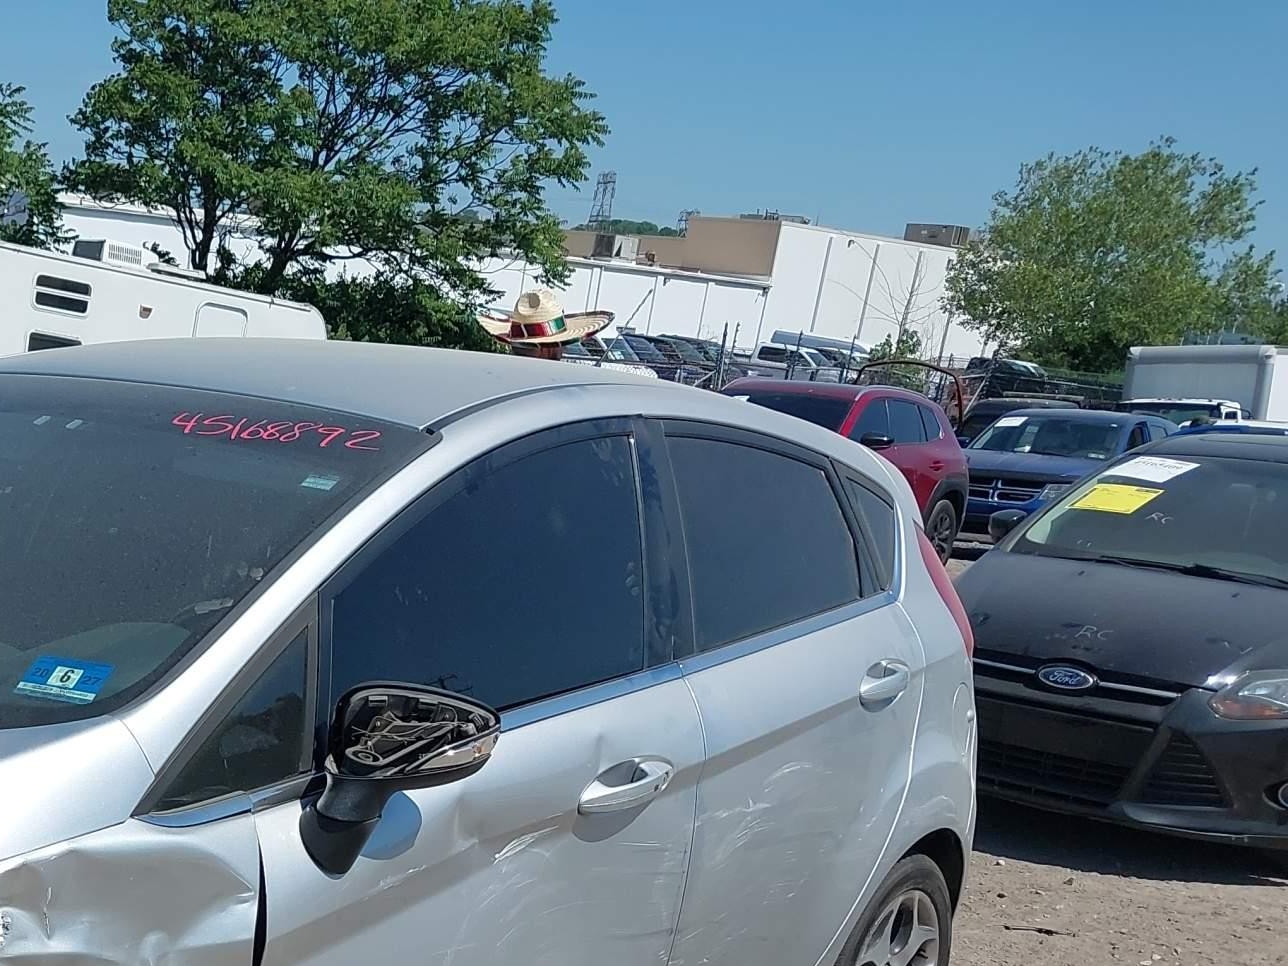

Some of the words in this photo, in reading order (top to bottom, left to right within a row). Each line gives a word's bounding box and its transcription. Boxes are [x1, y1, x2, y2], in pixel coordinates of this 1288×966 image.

[172, 412, 381, 450] 45168892
[33, 668, 49, 678] 20
[59, 669, 75, 683] 6
[1048, 670, 1081, 685] Ford
